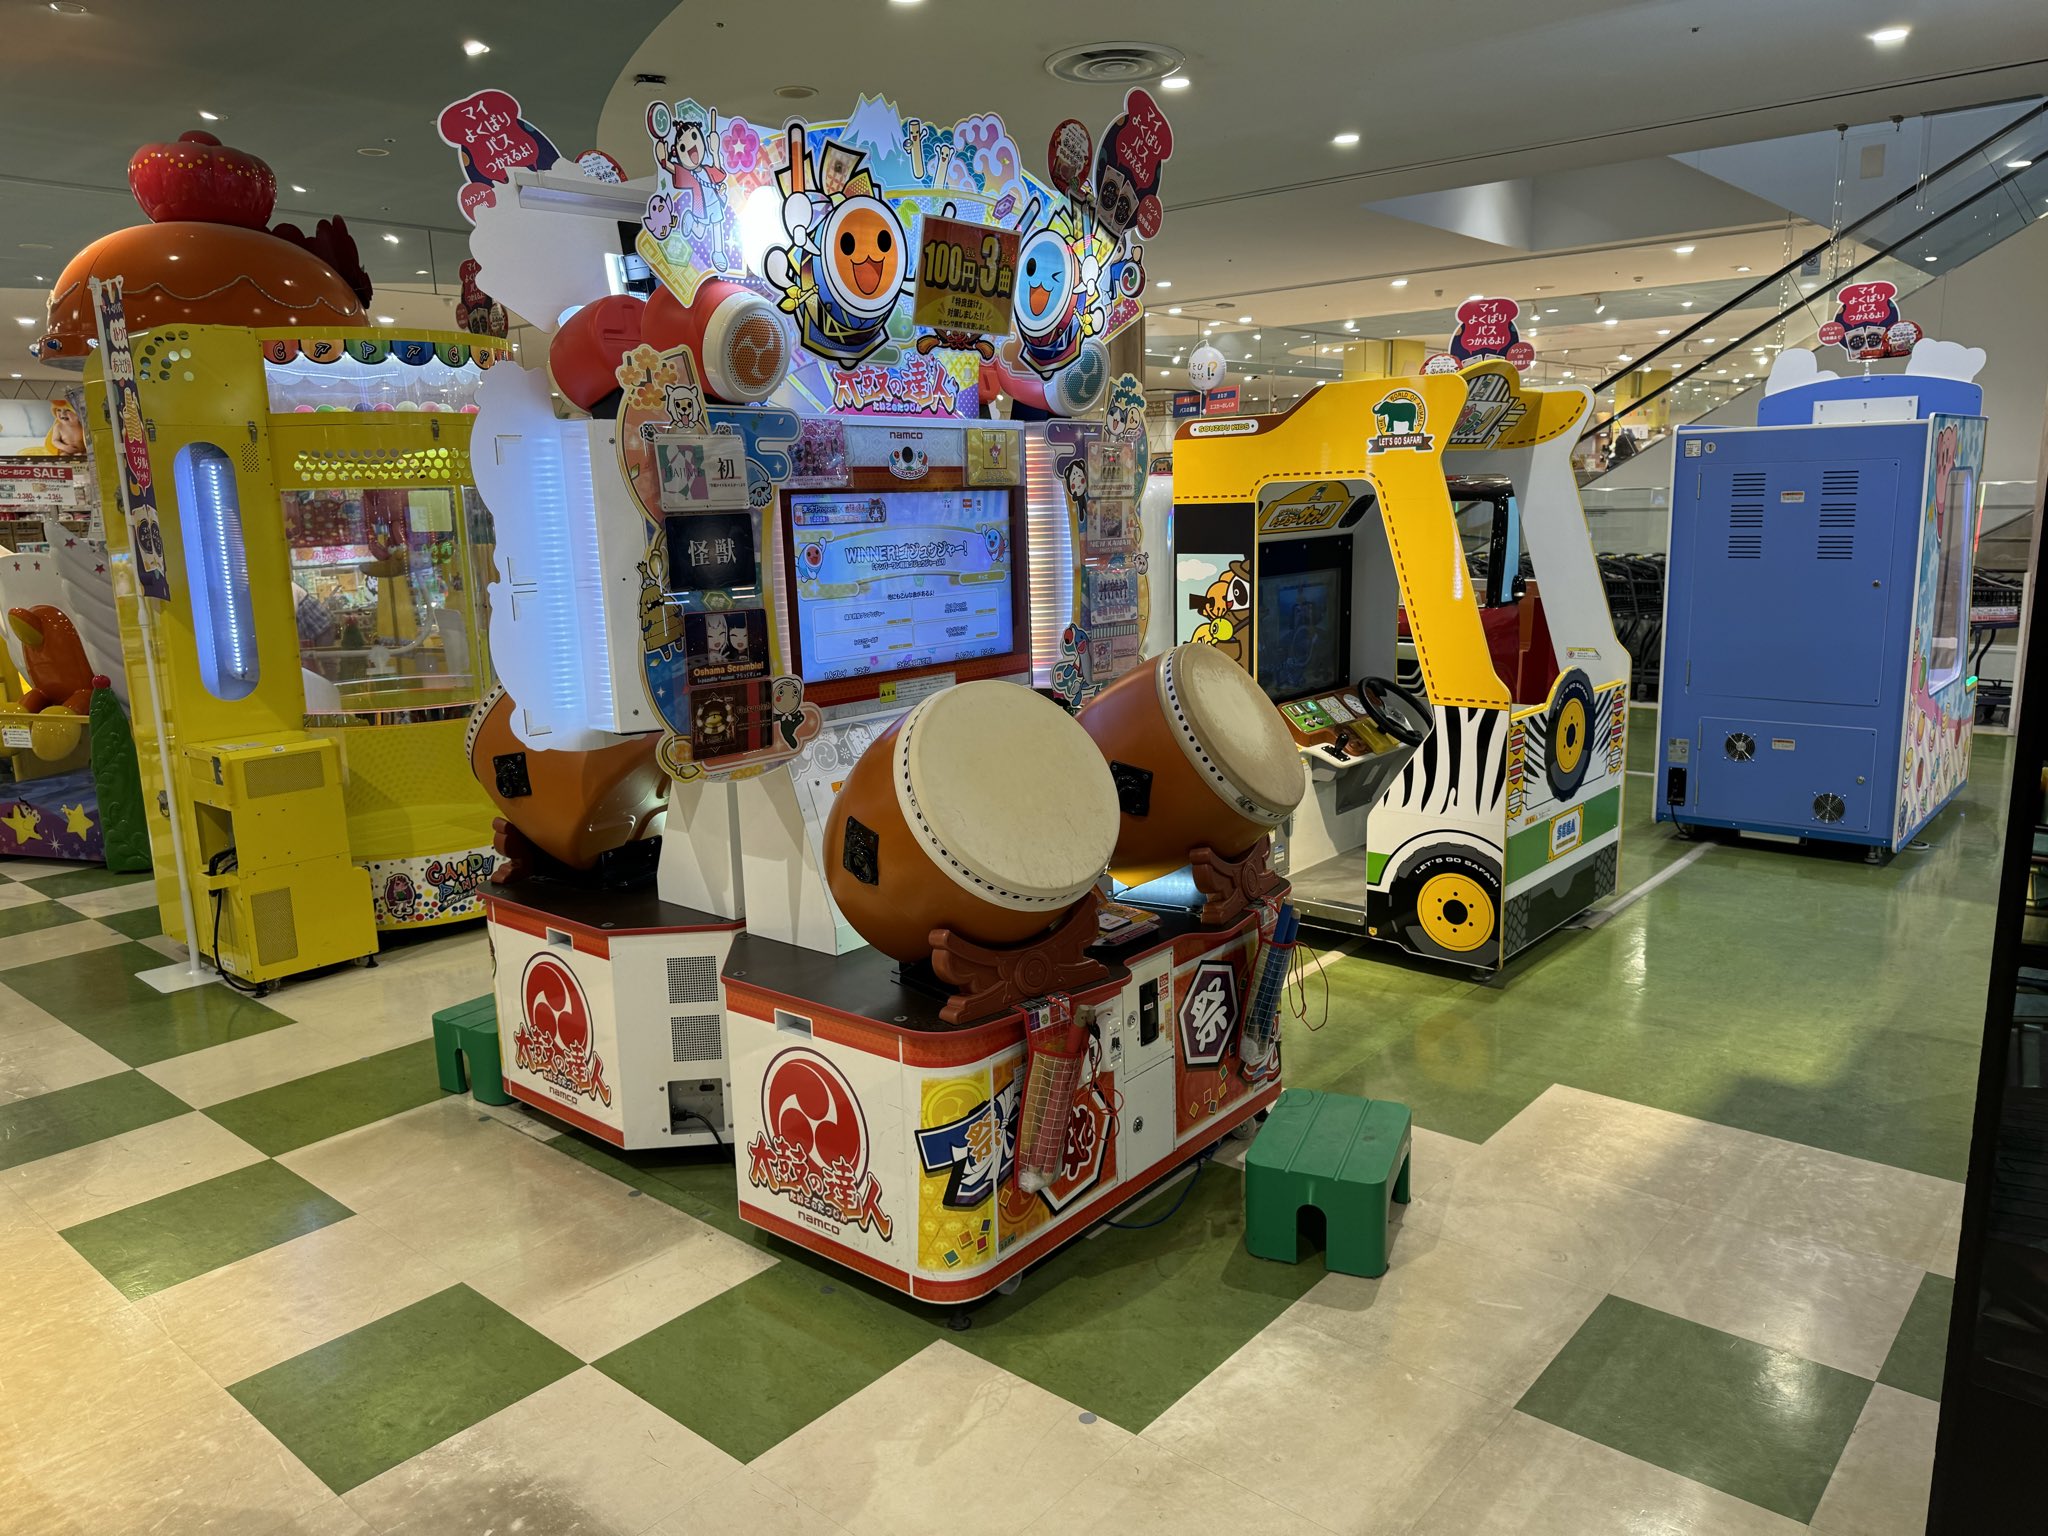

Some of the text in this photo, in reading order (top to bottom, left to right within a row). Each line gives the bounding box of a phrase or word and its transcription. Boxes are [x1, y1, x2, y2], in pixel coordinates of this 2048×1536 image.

[461, 100, 488, 120] マイ
[1148, 106, 1161, 132] マイ
[465, 111, 511, 144] よくばり
[1133, 115, 1161, 155] よくばり
[485, 134, 514, 156] パス
[1131, 137, 1148, 163] パス
[485, 144, 534, 173] つかえるよ!
[1121, 142, 1149, 182] つかえるよ!
[464, 189, 491, 207] カウンター
[1849, 294, 1885, 304] よくばり
[1858, 286, 1876, 294] マイ
[1468, 313, 1507, 324] よくばり
[1479, 302, 1497, 313] マイ
[1848, 312, 1885, 320] つかえるよ!
[1857, 304, 1876, 312] パス
[1467, 336, 1505, 346] つかえるよ!
[1476, 325, 1497, 336] パス
[1510, 347, 1532, 355] カウンター
[834, 360, 955, 413] 太鼓の達人
[1388, 390, 1409, 402] WORLD
[1409, 392, 1419, 402] OF
[890, 431, 923, 440] namco
[1198, 423, 1249, 433] SOUZOU KIDS
[1378, 435, 1422, 446] LET'S GO SAFARI
[33, 467, 66, 478] SALE
[717, 457, 735, 480] 初
[687, 538, 737, 567] 怪獣
[845, 541, 968, 564] WINNER!ゴジュウジャー!
[693, 662, 764, 677] Oshama Scramble!
[426, 854, 495, 886] CANDY
[1415, 856, 1499, 888] LET'S GO SAFARI
[1190, 977, 1228, 1053] 祭
[513, 1022, 612, 1108] 太鼓の達人
[549, 1086, 577, 1105] namco
[964, 1110, 1001, 1163] 祭
[748, 1131, 894, 1242] 太鼓の達人
[788, 1191, 849, 1225] たいこのたつじん
[797, 1210, 841, 1236] namco
